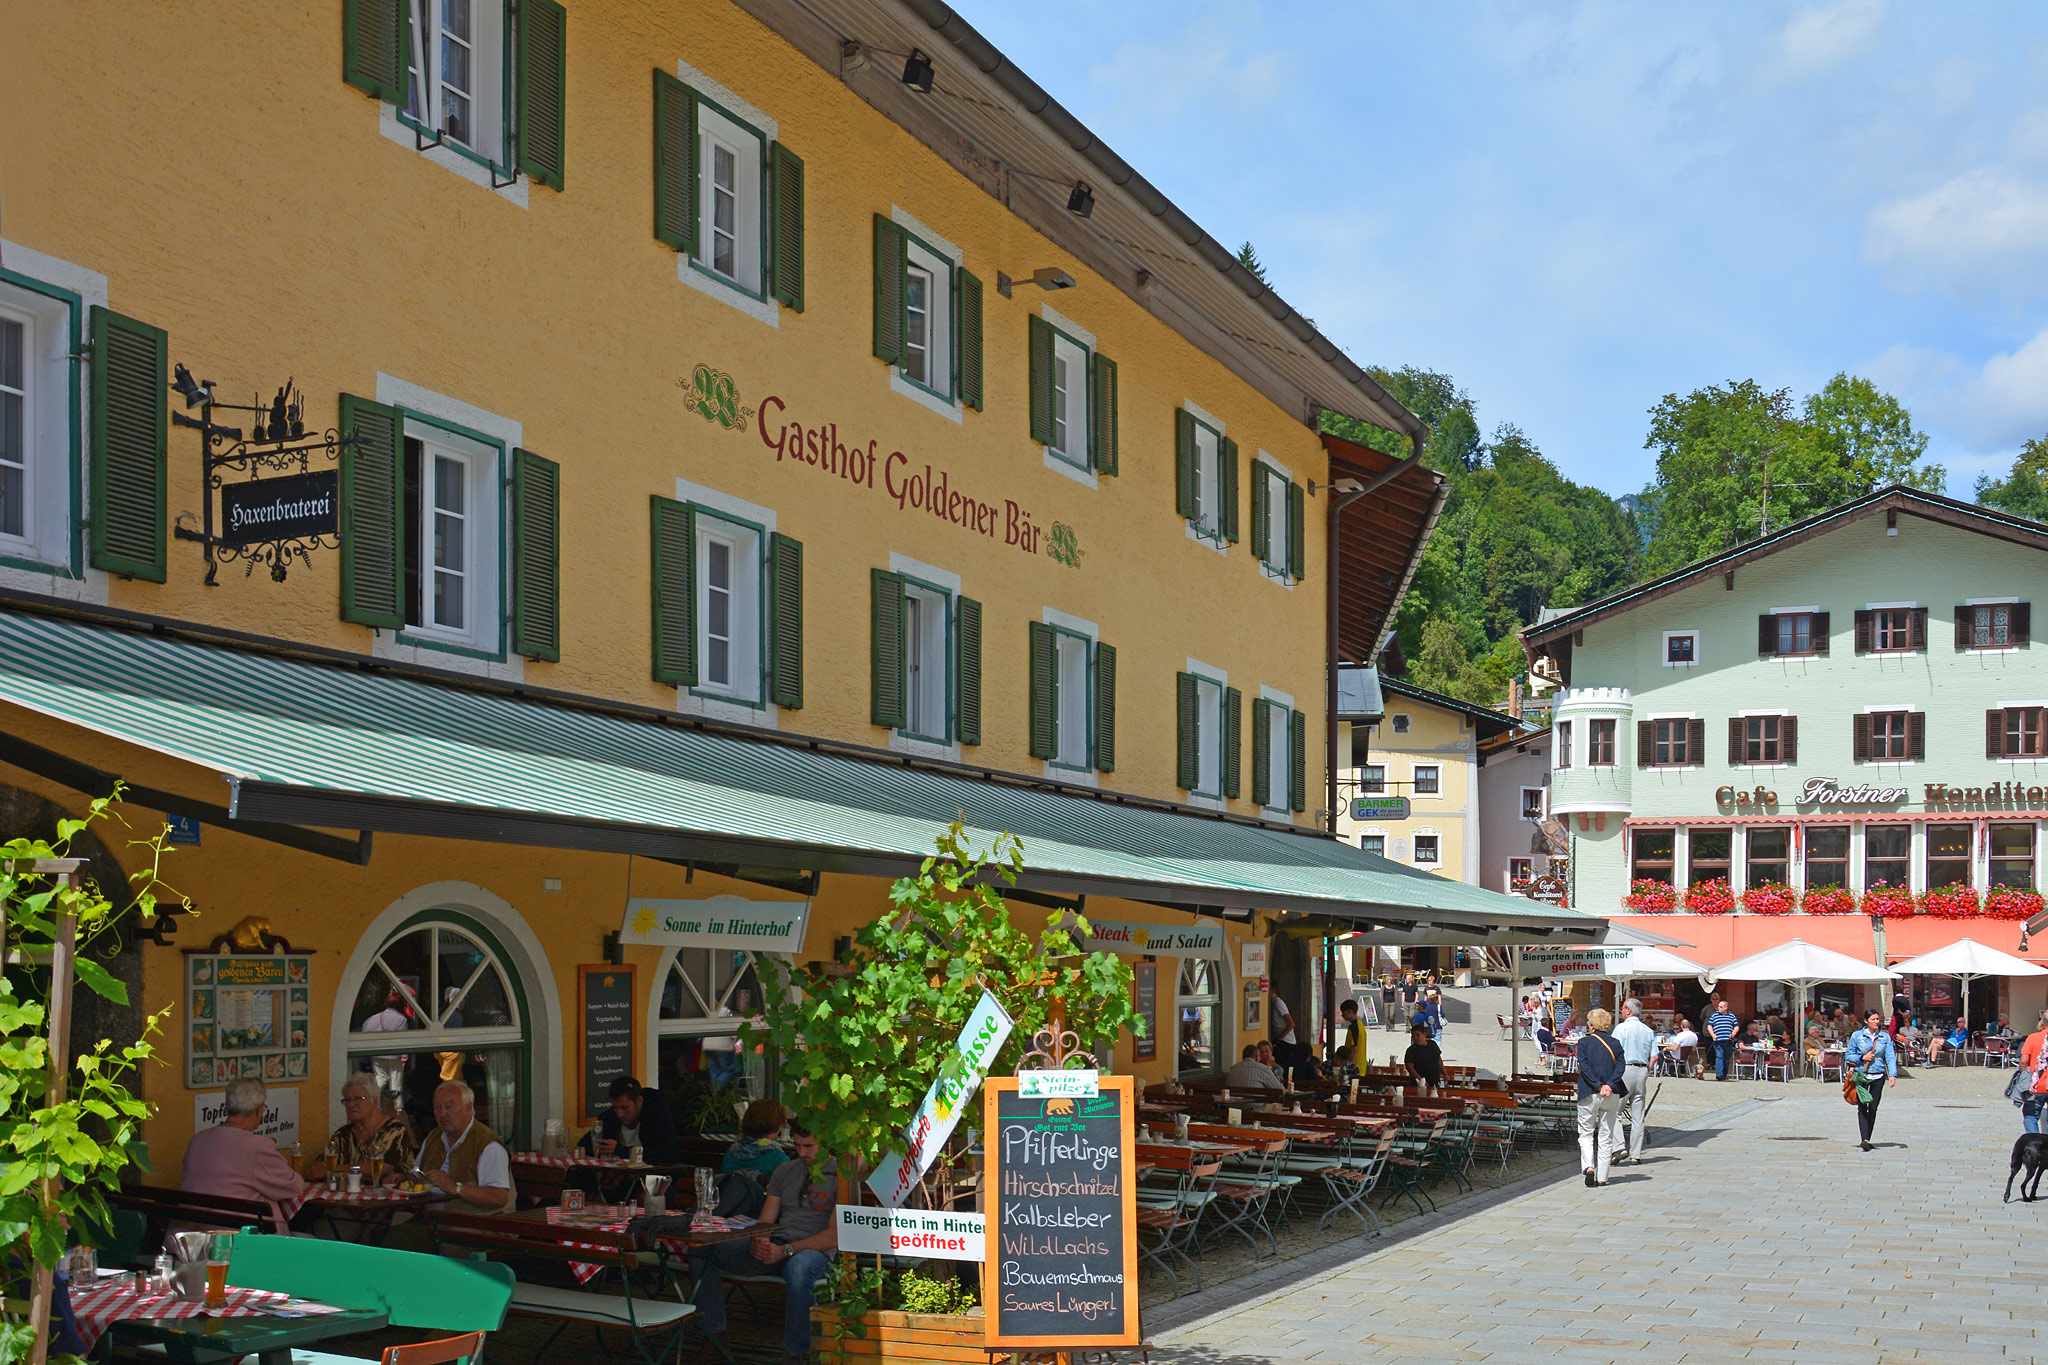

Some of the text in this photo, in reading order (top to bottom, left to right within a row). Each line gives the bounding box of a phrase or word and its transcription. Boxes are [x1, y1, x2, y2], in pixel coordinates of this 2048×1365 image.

[758, 395, 1041, 555] Gasthof Goldener Bär
[230, 491, 331, 531] Haxenbraterei
[1715, 785, 1779, 807] Cafe
[1795, 776, 1908, 805] Forstner
[1358, 799, 1404, 808] BARMER
[1358, 808, 1379, 817] GEK
[180, 816, 189, 831] 4
[663, 916, 794, 937] Sonne im Hinterhof
[1092, 923, 1213, 950] Steak und Salat
[1522, 950, 1629, 963] Biergarten im Hinterhof
[1551, 961, 1600, 973] geöffnet
[935, 1015, 1000, 1112] Terrasse
[1041, 1075, 1081, 1084] Stein-
[1048, 1084, 1083, 1095] pilze
[201, 1103, 279, 1125] Topfedel
[265, 1124, 279, 1135] dem
[279, 1121, 295, 1132] Ofen
[1034, 1123, 1069, 1133] Golener
[1002, 1124, 1119, 1171] Pfifferlinge
[1003, 1169, 1120, 1198] Hirschschnitzel
[843, 1210, 918, 1230] Biergarten
[921, 1216, 939, 1231] im
[1003, 1201, 1112, 1229] Kalbsleber
[889, 1233, 966, 1251] geöffnet
